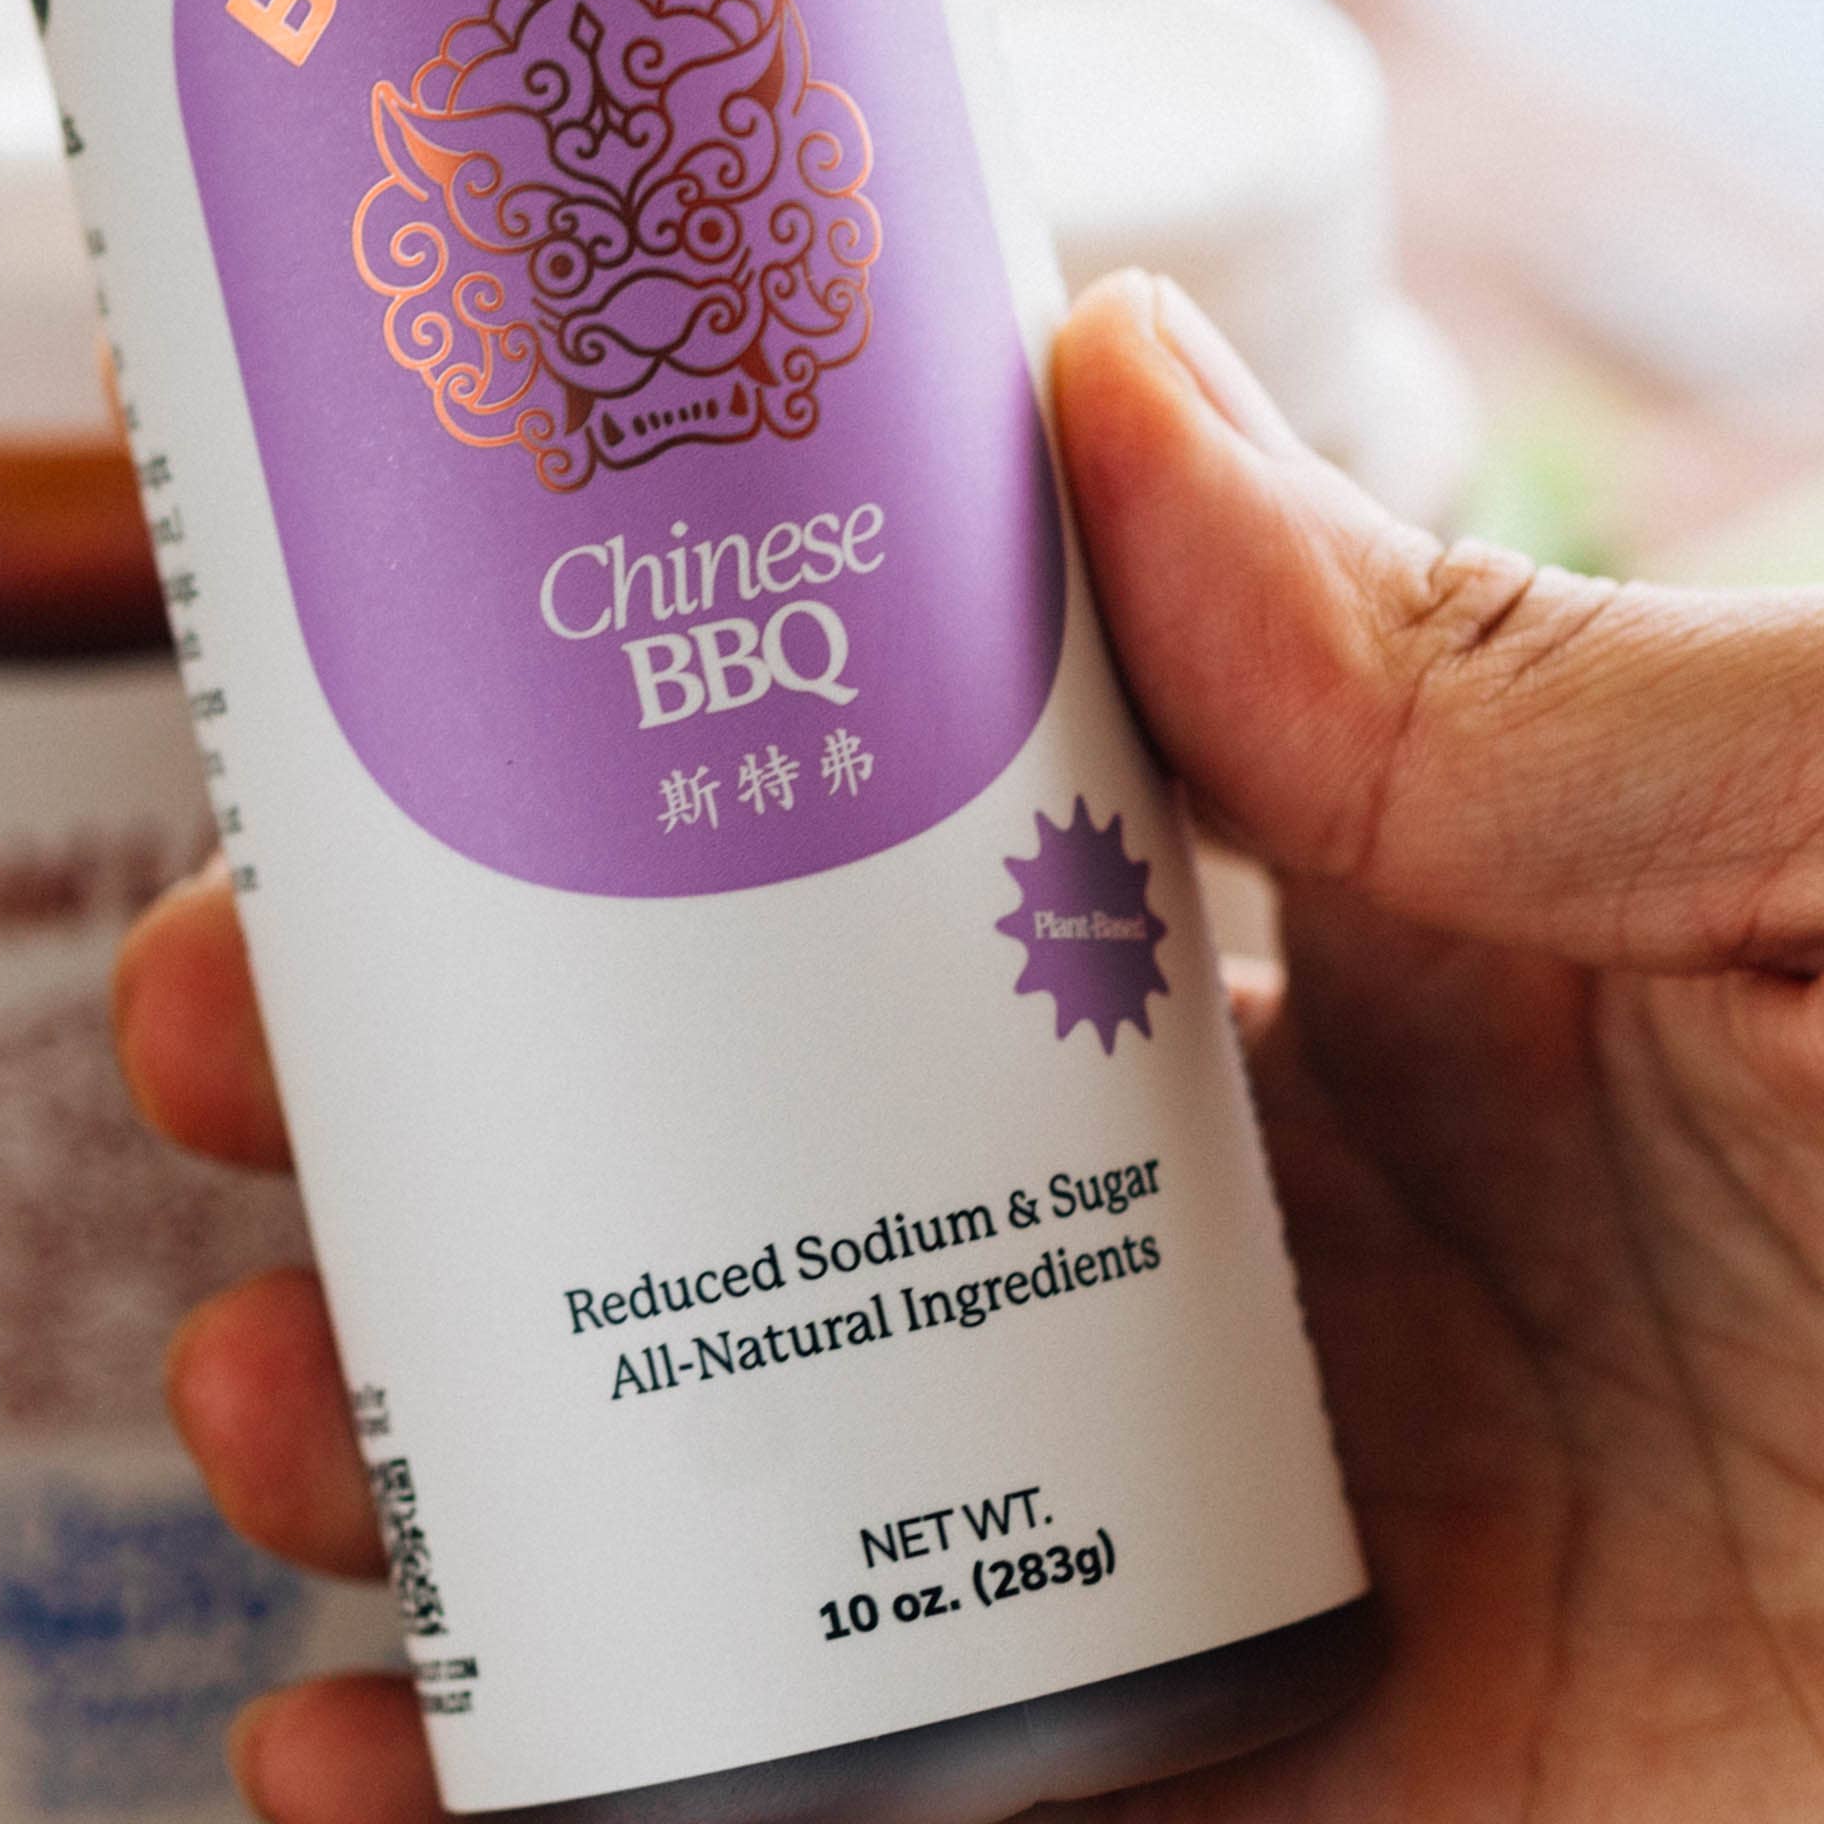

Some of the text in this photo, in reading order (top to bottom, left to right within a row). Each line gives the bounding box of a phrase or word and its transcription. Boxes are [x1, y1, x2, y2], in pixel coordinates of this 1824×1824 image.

[539, 502, 885, 641] Chinese
[621, 599, 860, 730] BBQ
[656, 727, 876, 835] 斯特弗
[1033, 909, 1147, 941] Plant-Based
[563, 1158, 1161, 1334] Reduced Sodium & Sugar
[610, 1233, 1162, 1401] All-Natural Ingredients
[818, 1528, 1117, 1641] 10 oz. (283g)
[860, 1486, 1054, 1569] NET WT.
